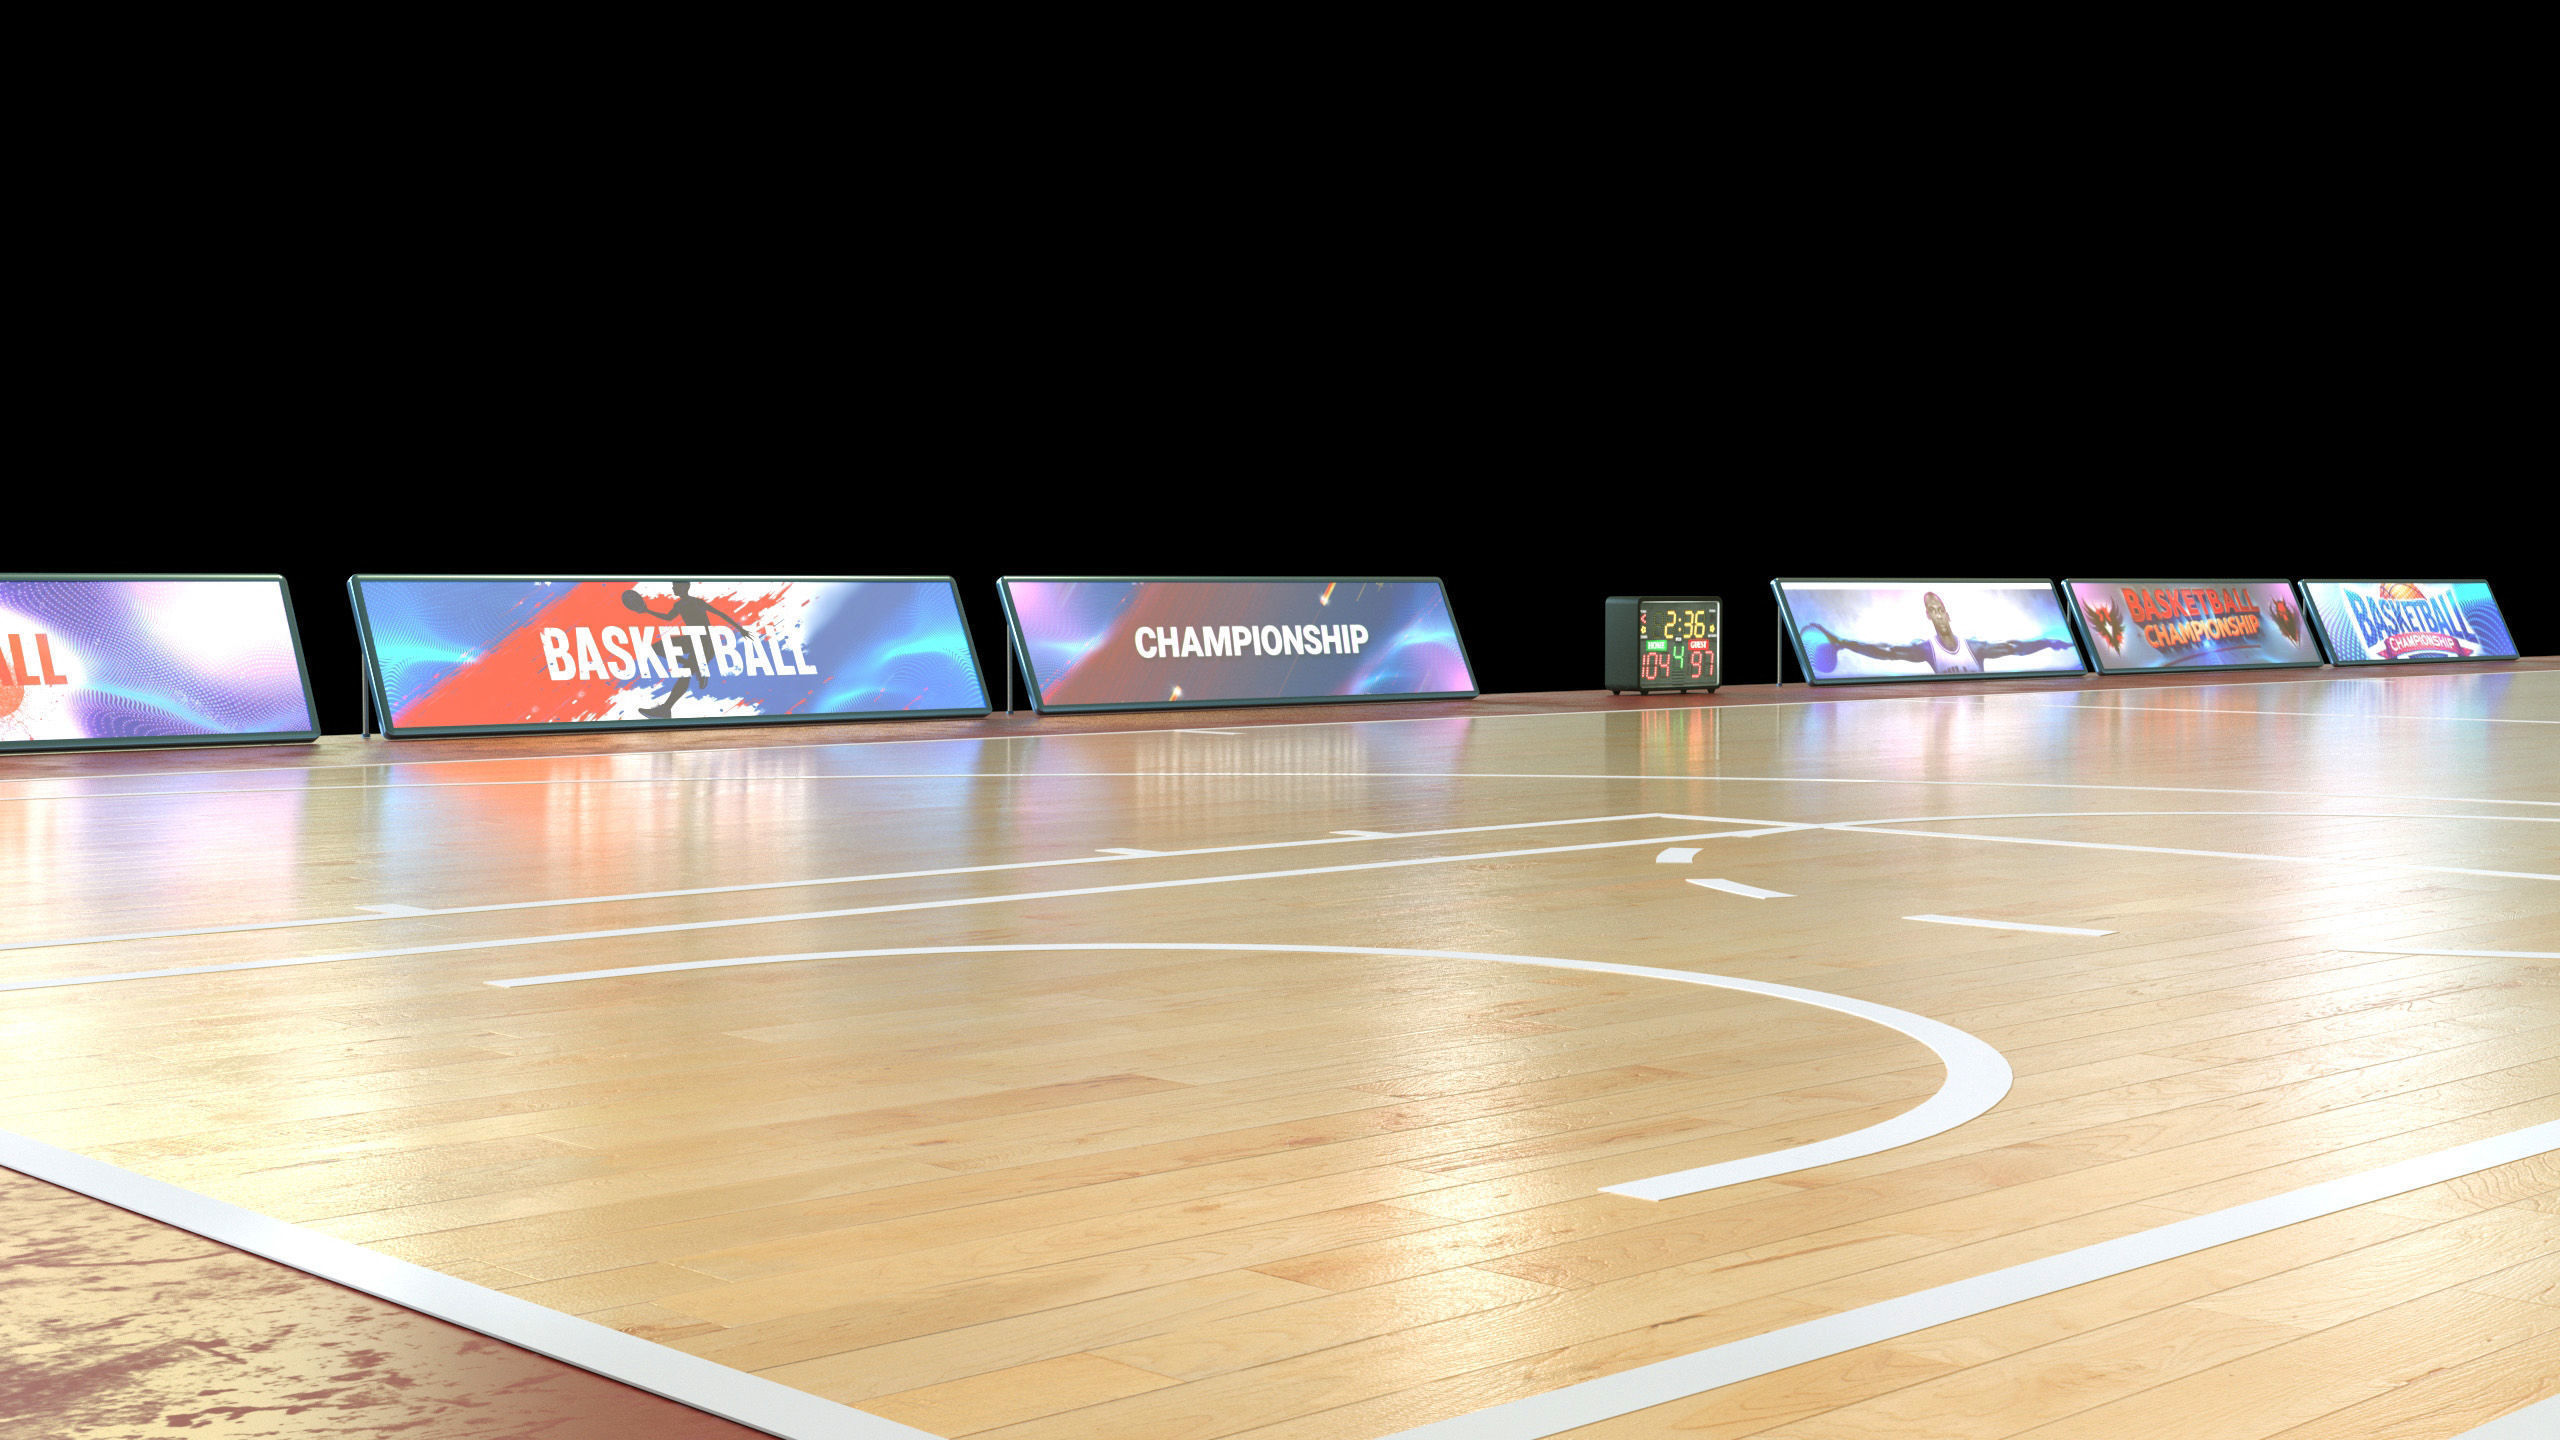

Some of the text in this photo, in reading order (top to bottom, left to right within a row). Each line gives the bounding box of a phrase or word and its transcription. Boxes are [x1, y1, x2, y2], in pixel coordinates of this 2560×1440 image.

[2121, 587, 2260, 623] BASKETBALL
[2343, 588, 2480, 649] BASKETBALL
[1664, 611, 1705, 638] 2:36
[2144, 615, 2260, 649] CHAMPIONSHIP
[540, 625, 818, 681] BASKETBALL
[1134, 624, 1369, 659] CHAMPIONSHIP
[2389, 633, 2455, 651] CHAMPIONSHIP
[1641, 652, 1671, 680] 104
[1673, 646, 1684, 669] 4
[1691, 651, 1714, 678] 97
